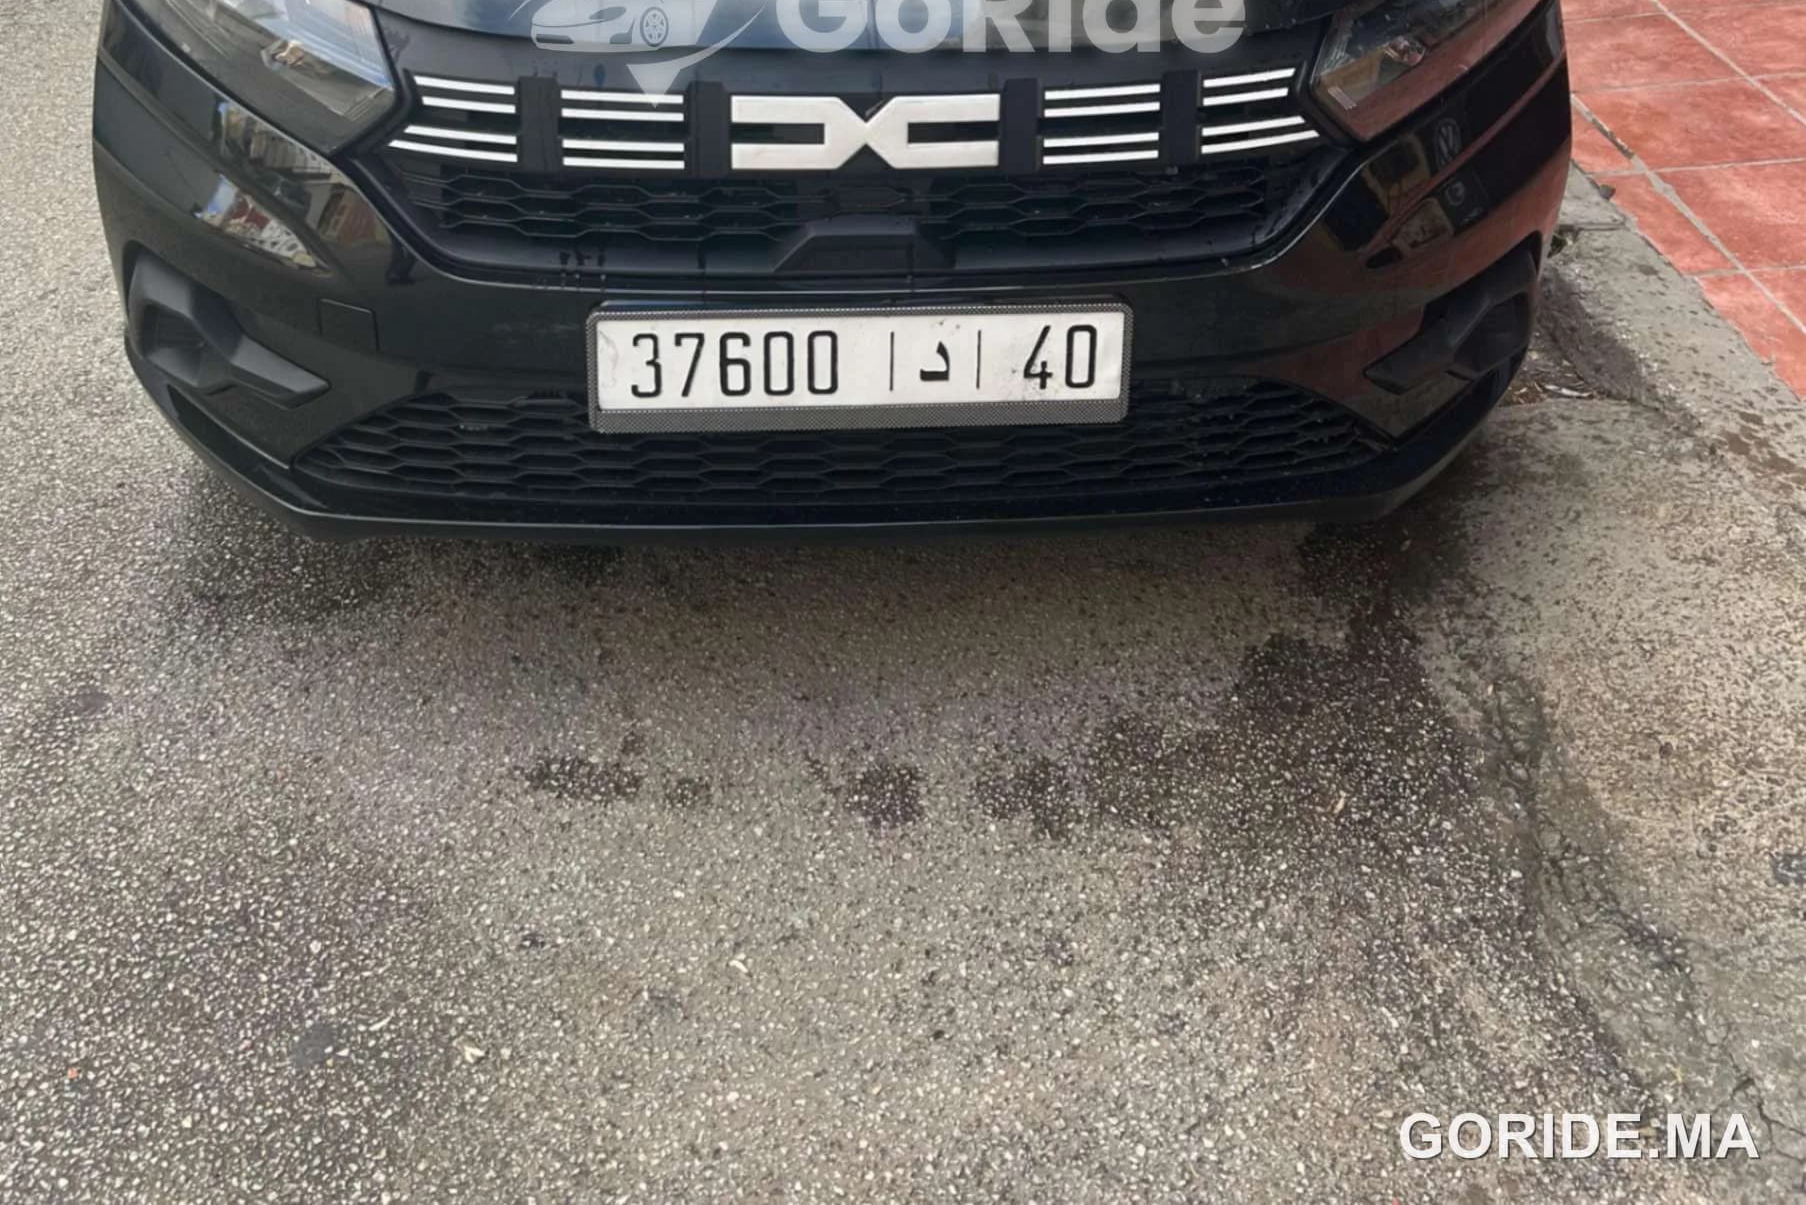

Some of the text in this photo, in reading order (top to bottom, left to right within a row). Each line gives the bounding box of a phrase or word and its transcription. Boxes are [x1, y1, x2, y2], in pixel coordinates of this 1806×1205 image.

[630, 324, 1098, 399] 37600 د 40
